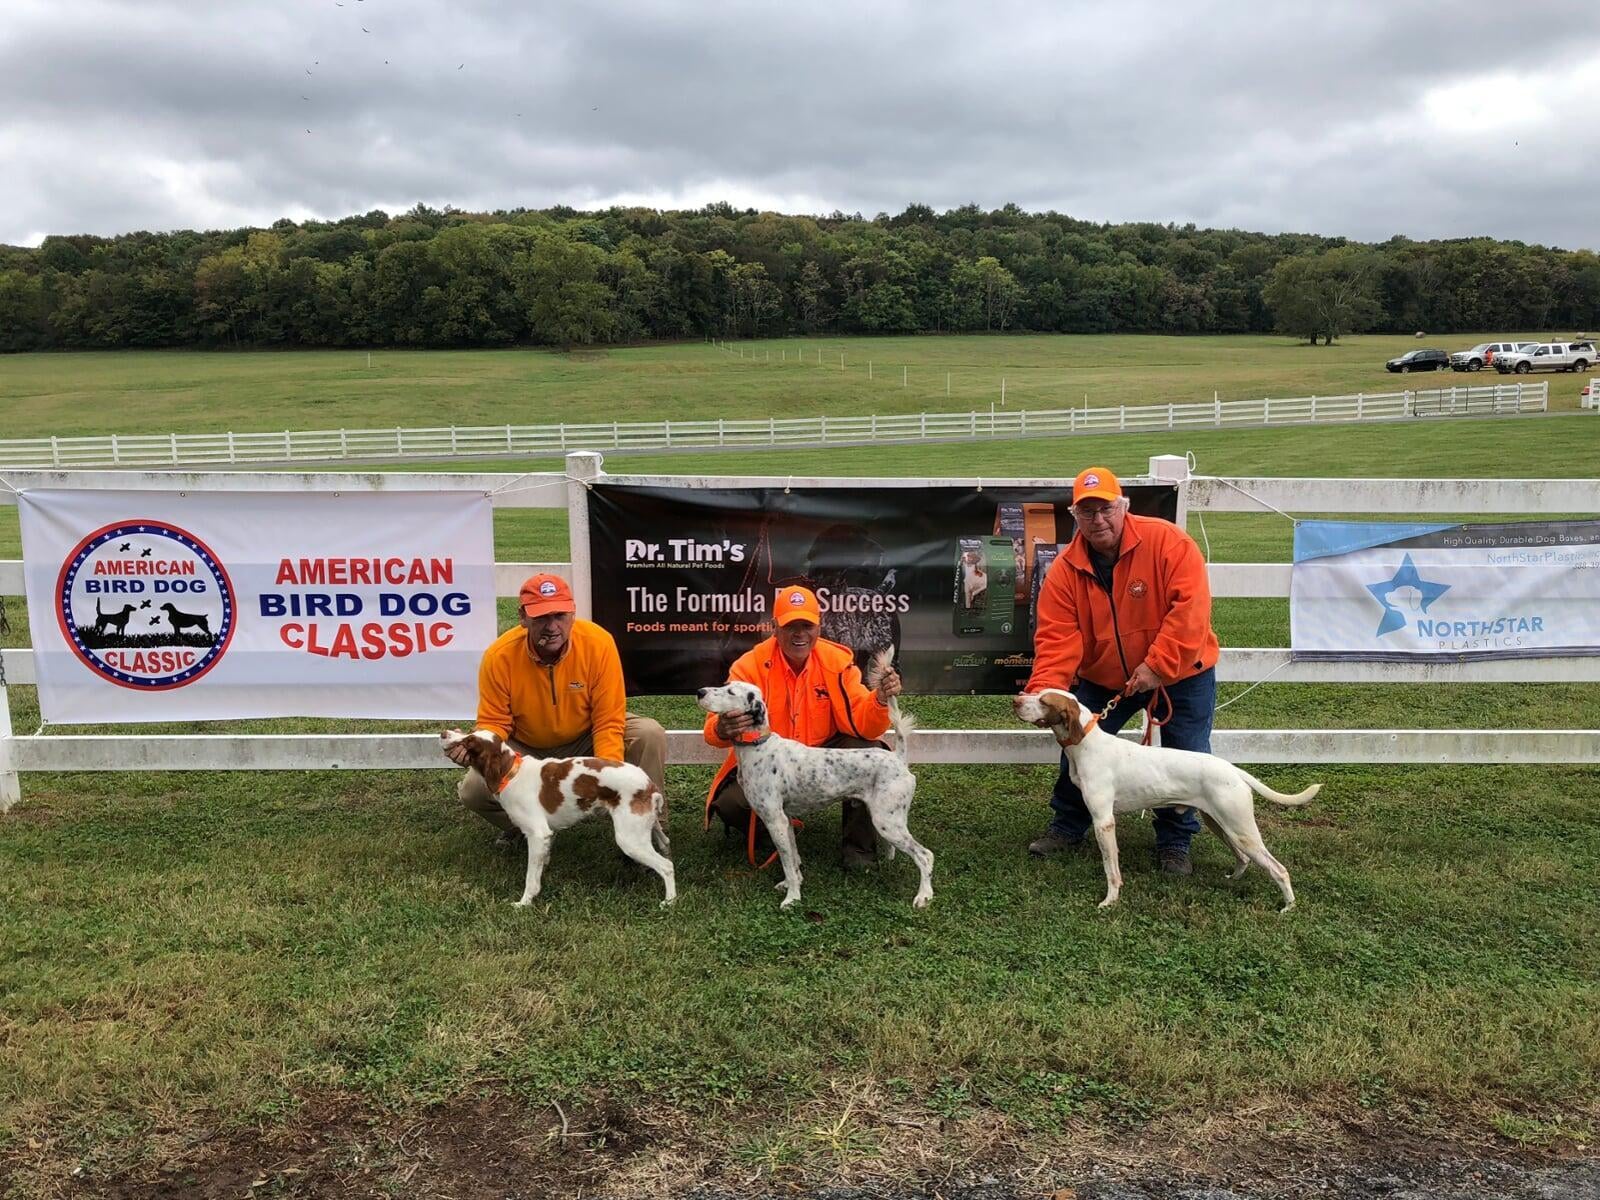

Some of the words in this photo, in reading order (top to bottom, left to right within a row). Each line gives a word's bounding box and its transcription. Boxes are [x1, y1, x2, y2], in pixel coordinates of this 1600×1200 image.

[625, 539, 665, 561] Dr.
[668, 538, 745, 562] Tim's
[1443, 536, 1463, 547] High
[1499, 535, 1533, 544] Durable
[1535, 535, 1556, 545] Dog
[94, 560, 195, 576] AMERICAN
[275, 558, 453, 585] AMERICAN
[85, 580, 145, 594] BIRD
[154, 579, 207, 594] DOG
[259, 593, 364, 617] BIRD
[379, 592, 471, 617] DOG
[626, 587, 668, 613] The
[676, 587, 766, 613] Formula
[816, 587, 910, 613] Success
[627, 622, 666, 632] Foods
[669, 622, 708, 632] meant
[712, 621, 730, 632] for
[734, 621, 776, 634] sporti
[1417, 616, 1544, 638] NORTHSTAR
[280, 622, 454, 660] CLASSIC
[1438, 636, 1522, 650] PLASTICS
[105, 651, 196, 674] CLASSIC
[994, 657, 1035, 666] moment
